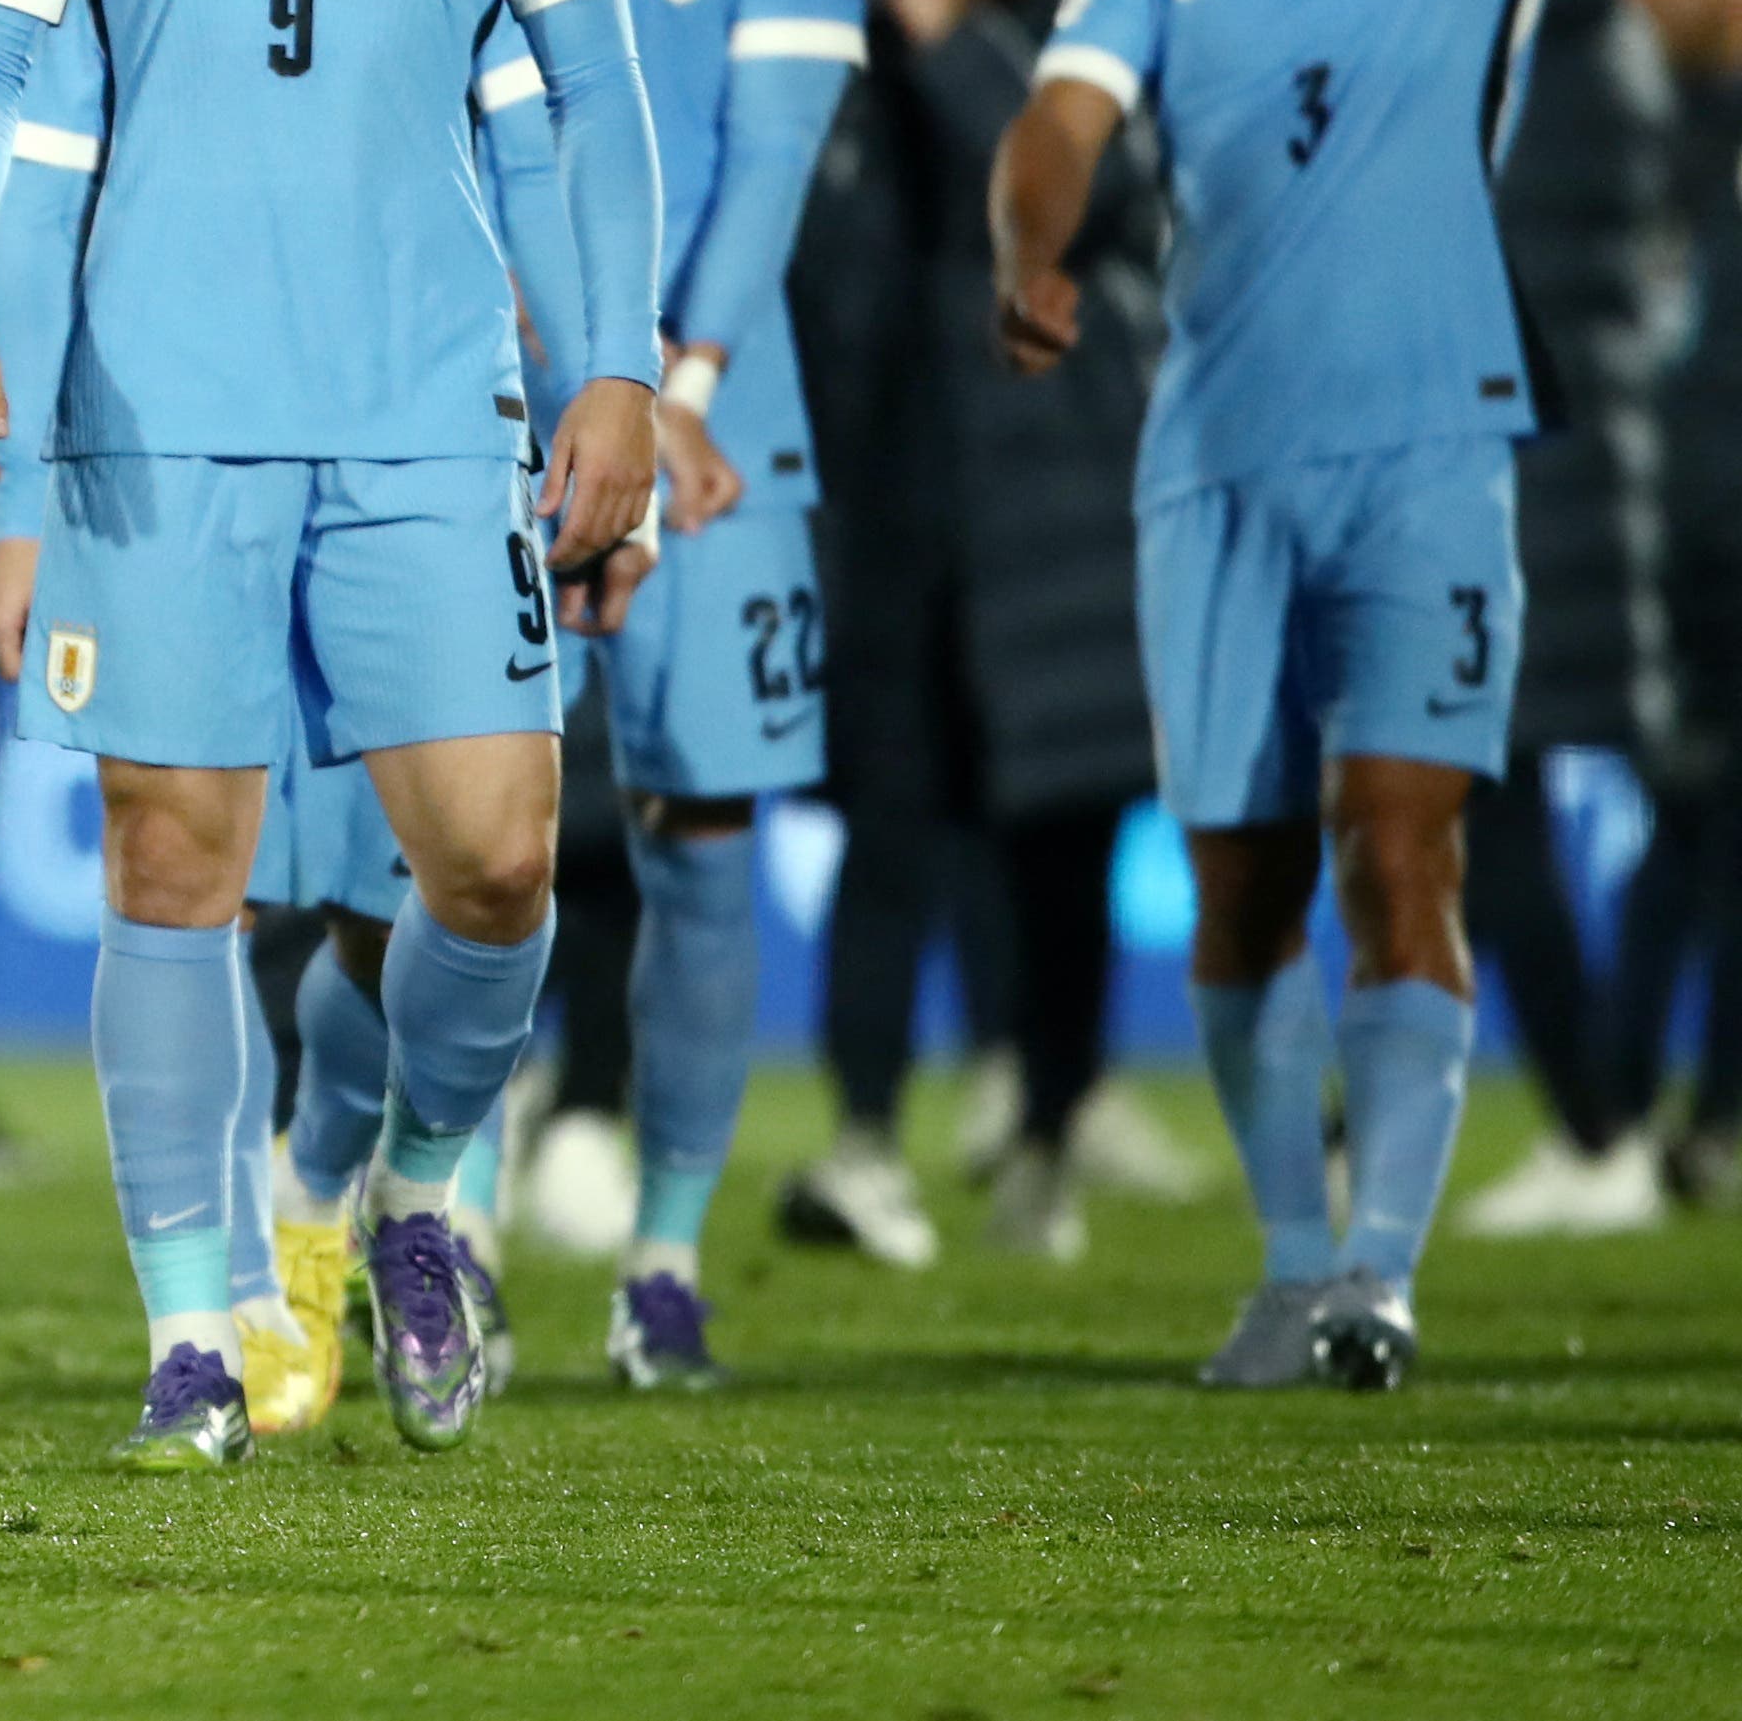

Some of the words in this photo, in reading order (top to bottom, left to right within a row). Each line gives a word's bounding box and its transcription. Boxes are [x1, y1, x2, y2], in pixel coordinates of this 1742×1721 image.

[1287, 63, 1333, 167] 3
[506, 531, 549, 645] 9
[1449, 585, 1490, 689] 3
[740, 586, 824, 699] 22
